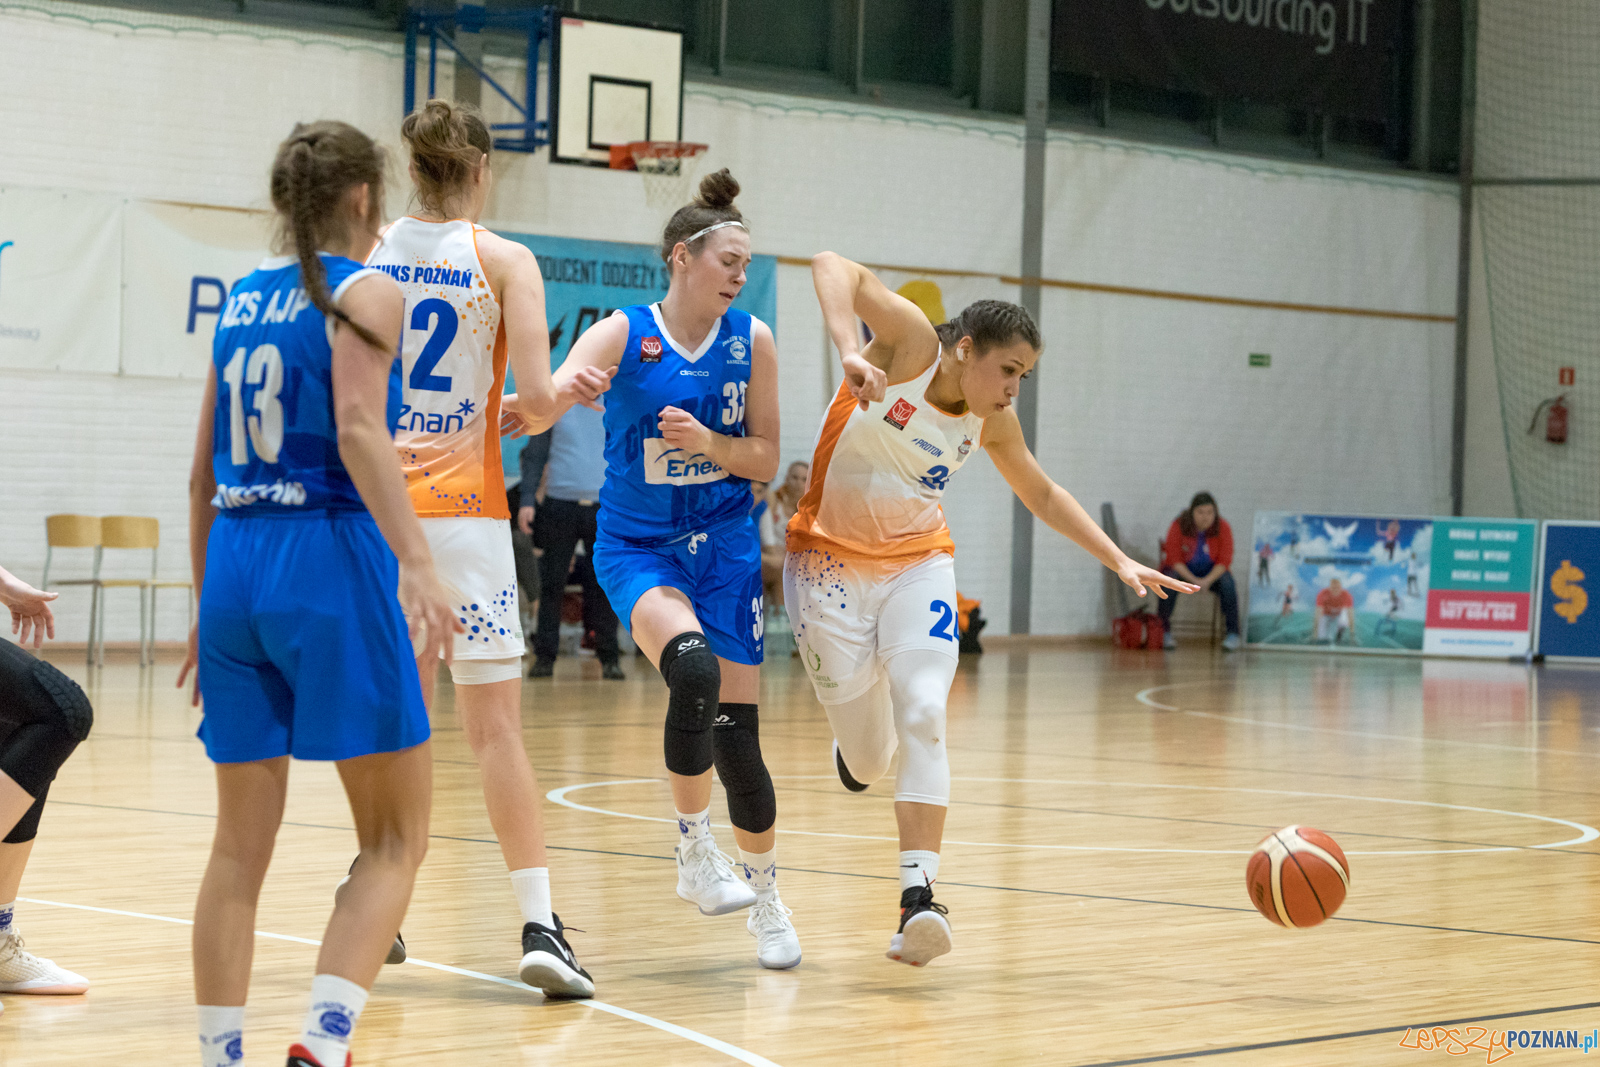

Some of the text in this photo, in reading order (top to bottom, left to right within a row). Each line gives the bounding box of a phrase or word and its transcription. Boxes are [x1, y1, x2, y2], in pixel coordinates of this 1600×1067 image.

[1145, 0, 1375, 53] sourcing IT
[413, 266, 472, 289] POZNAŃ
[219, 287, 311, 330] AZS AJP
[409, 297, 459, 393] 2
[223, 343, 285, 466] 13
[914, 438, 945, 458] PROTON
